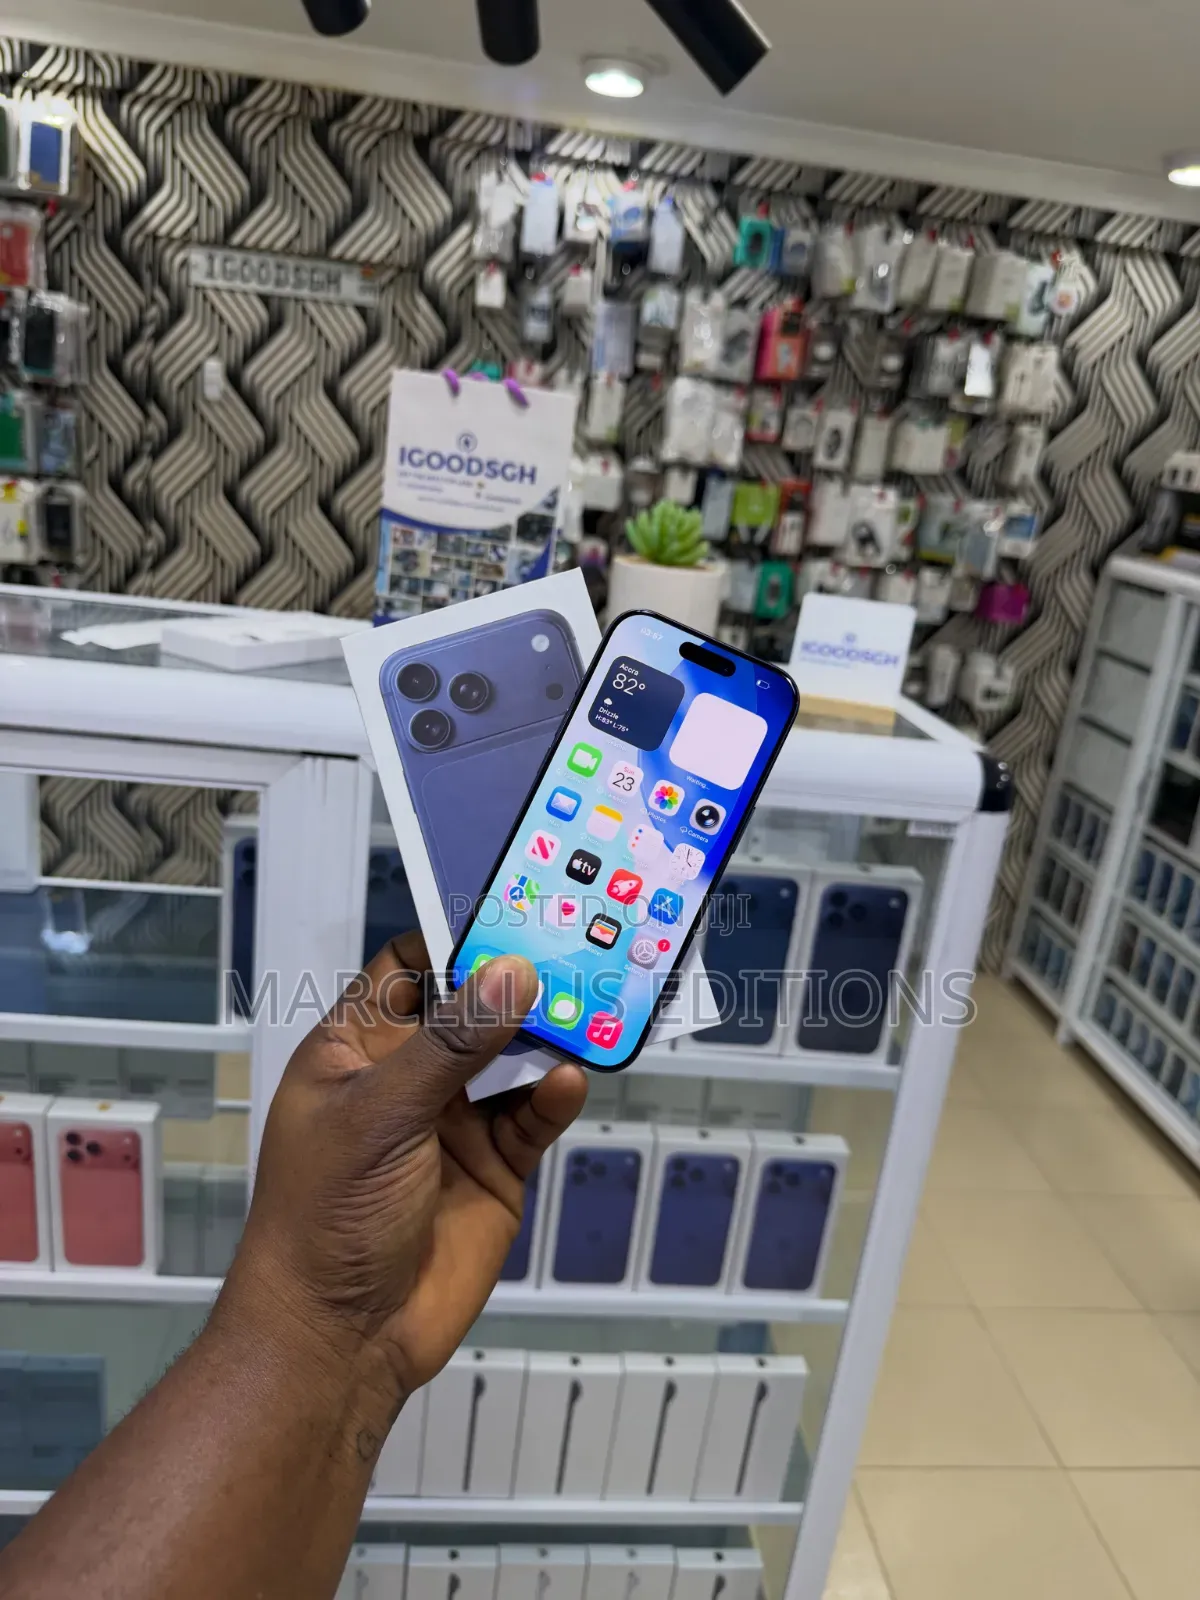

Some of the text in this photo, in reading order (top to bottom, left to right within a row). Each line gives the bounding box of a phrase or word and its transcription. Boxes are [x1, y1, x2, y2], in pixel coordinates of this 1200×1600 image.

[398, 446, 538, 486] IGOODSGH
[619, 663, 640, 677] Accra
[599, 706, 619, 720] Drizzle
[612, 772, 635, 792] 23
[687, 829, 709, 844] Camera
